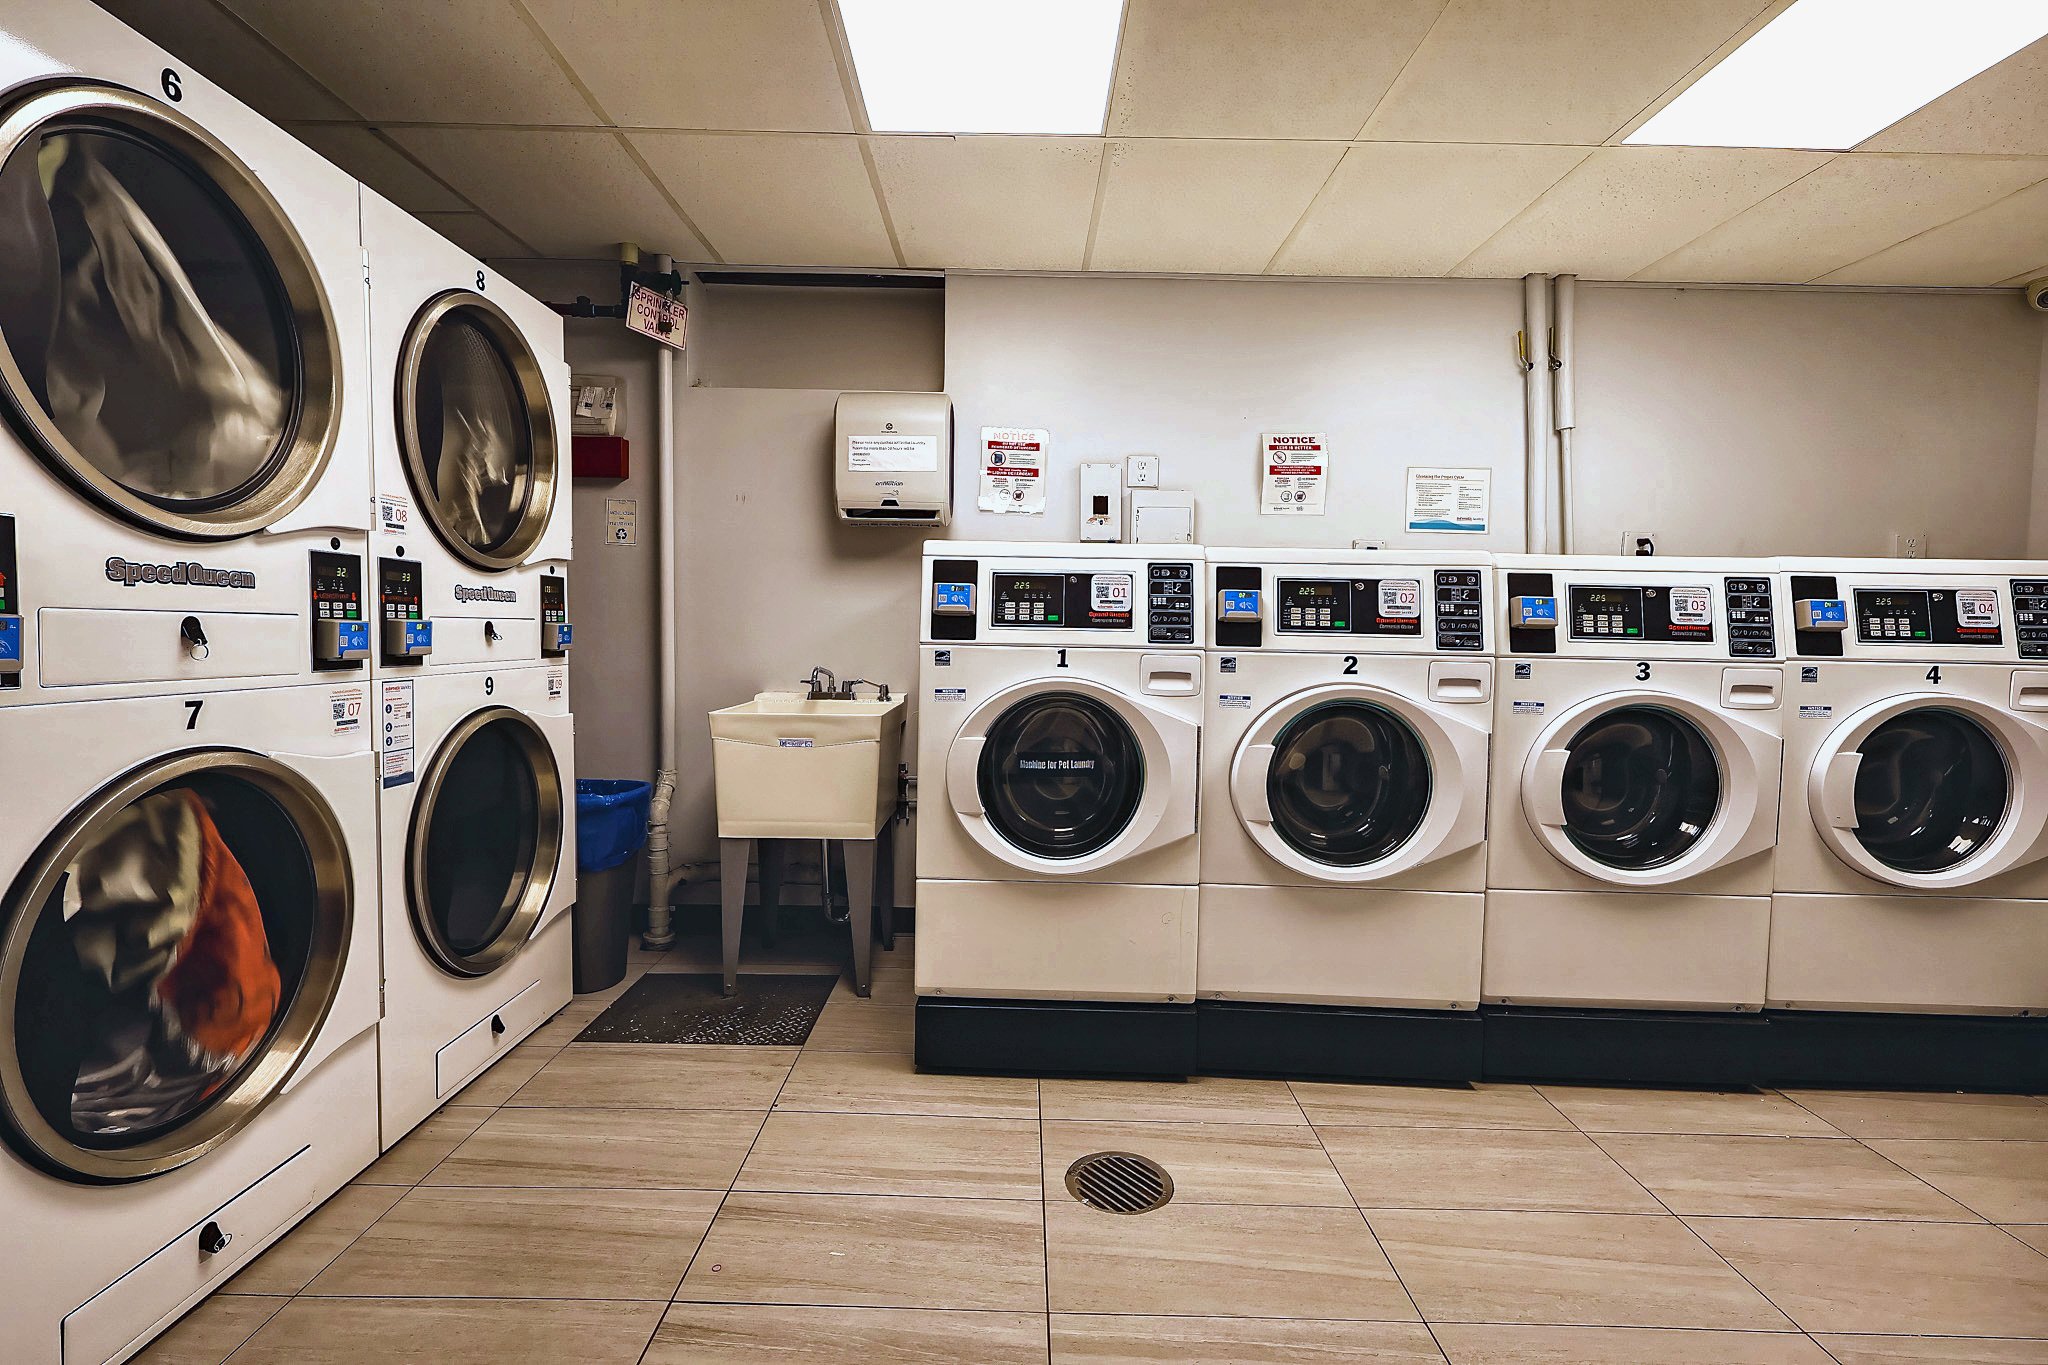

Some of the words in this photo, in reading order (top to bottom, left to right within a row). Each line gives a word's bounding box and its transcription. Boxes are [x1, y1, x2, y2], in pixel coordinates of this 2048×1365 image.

[161, 67, 182, 102] 6
[476, 270, 485, 291] 8
[643, 318, 671, 339] VALE
[993, 432, 1035, 441] NOTICE
[1273, 436, 1316, 444] NOTICE
[396, 508, 408, 522] 08
[105, 556, 188, 586] Speed
[188, 561, 256, 589] Queen
[336, 567, 347, 577] 32
[402, 573, 411, 582] 33
[454, 584, 487, 603] Speed
[487, 586, 517, 603] Queen
[1112, 587, 1128, 598] 01
[1400, 592, 1415, 604] 02
[1691, 600, 1706, 611] 03
[1978, 604, 1994, 614] 04
[1056, 649, 1068, 668] 1
[1343, 656, 1358, 674] 2
[1635, 662, 1651, 681] 3
[1925, 665, 1942, 684] 4
[485, 676, 494, 696] 9
[555, 680, 562, 688] 09
[184, 700, 204, 730] 7
[348, 702, 361, 716] 07
[1020, 760, 1046, 769] Machine
[1047, 760, 1057, 769] for
[1058, 760, 1069, 769] Pet
[1071, 760, 1094, 770] Laundry
